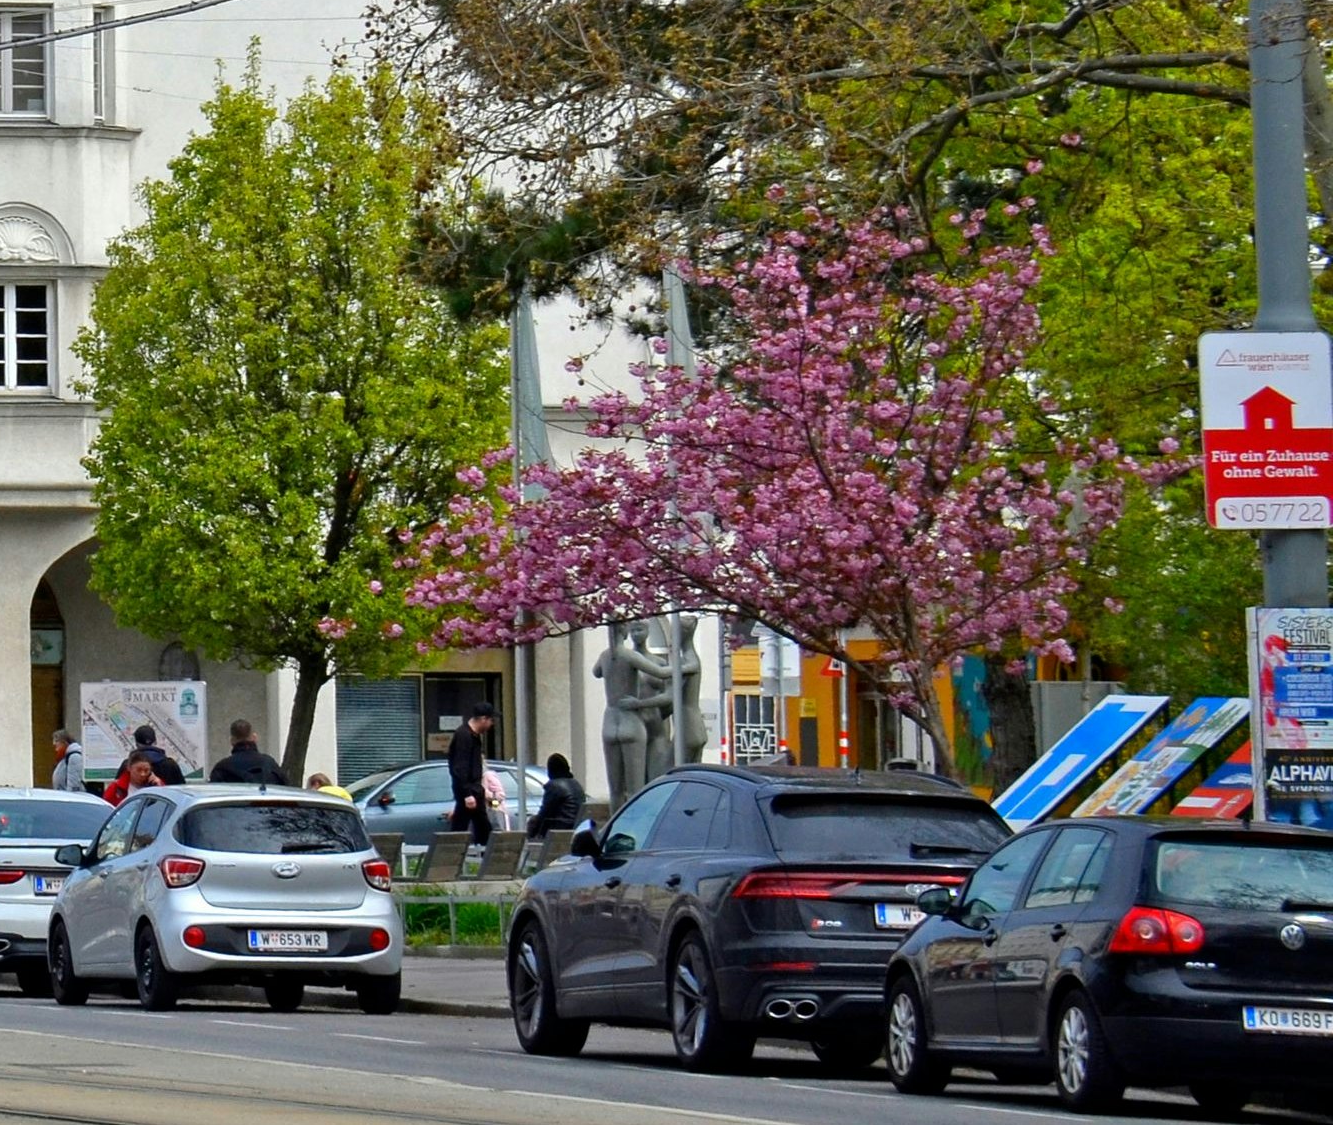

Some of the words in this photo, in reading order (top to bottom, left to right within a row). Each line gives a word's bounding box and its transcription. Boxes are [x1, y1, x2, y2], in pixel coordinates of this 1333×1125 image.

[1211, 449, 1238, 463] Für
[1239, 450, 1264, 463] ein
[1266, 449, 1329, 463] Zuhause
[1223, 465, 1262, 478] ohne
[1264, 465, 1319, 478] Gewalt.
[1283, 629, 1331, 644] FESTIVAL
[134, 692, 176, 703] MARKT
[901, 907, 912, 921] W
